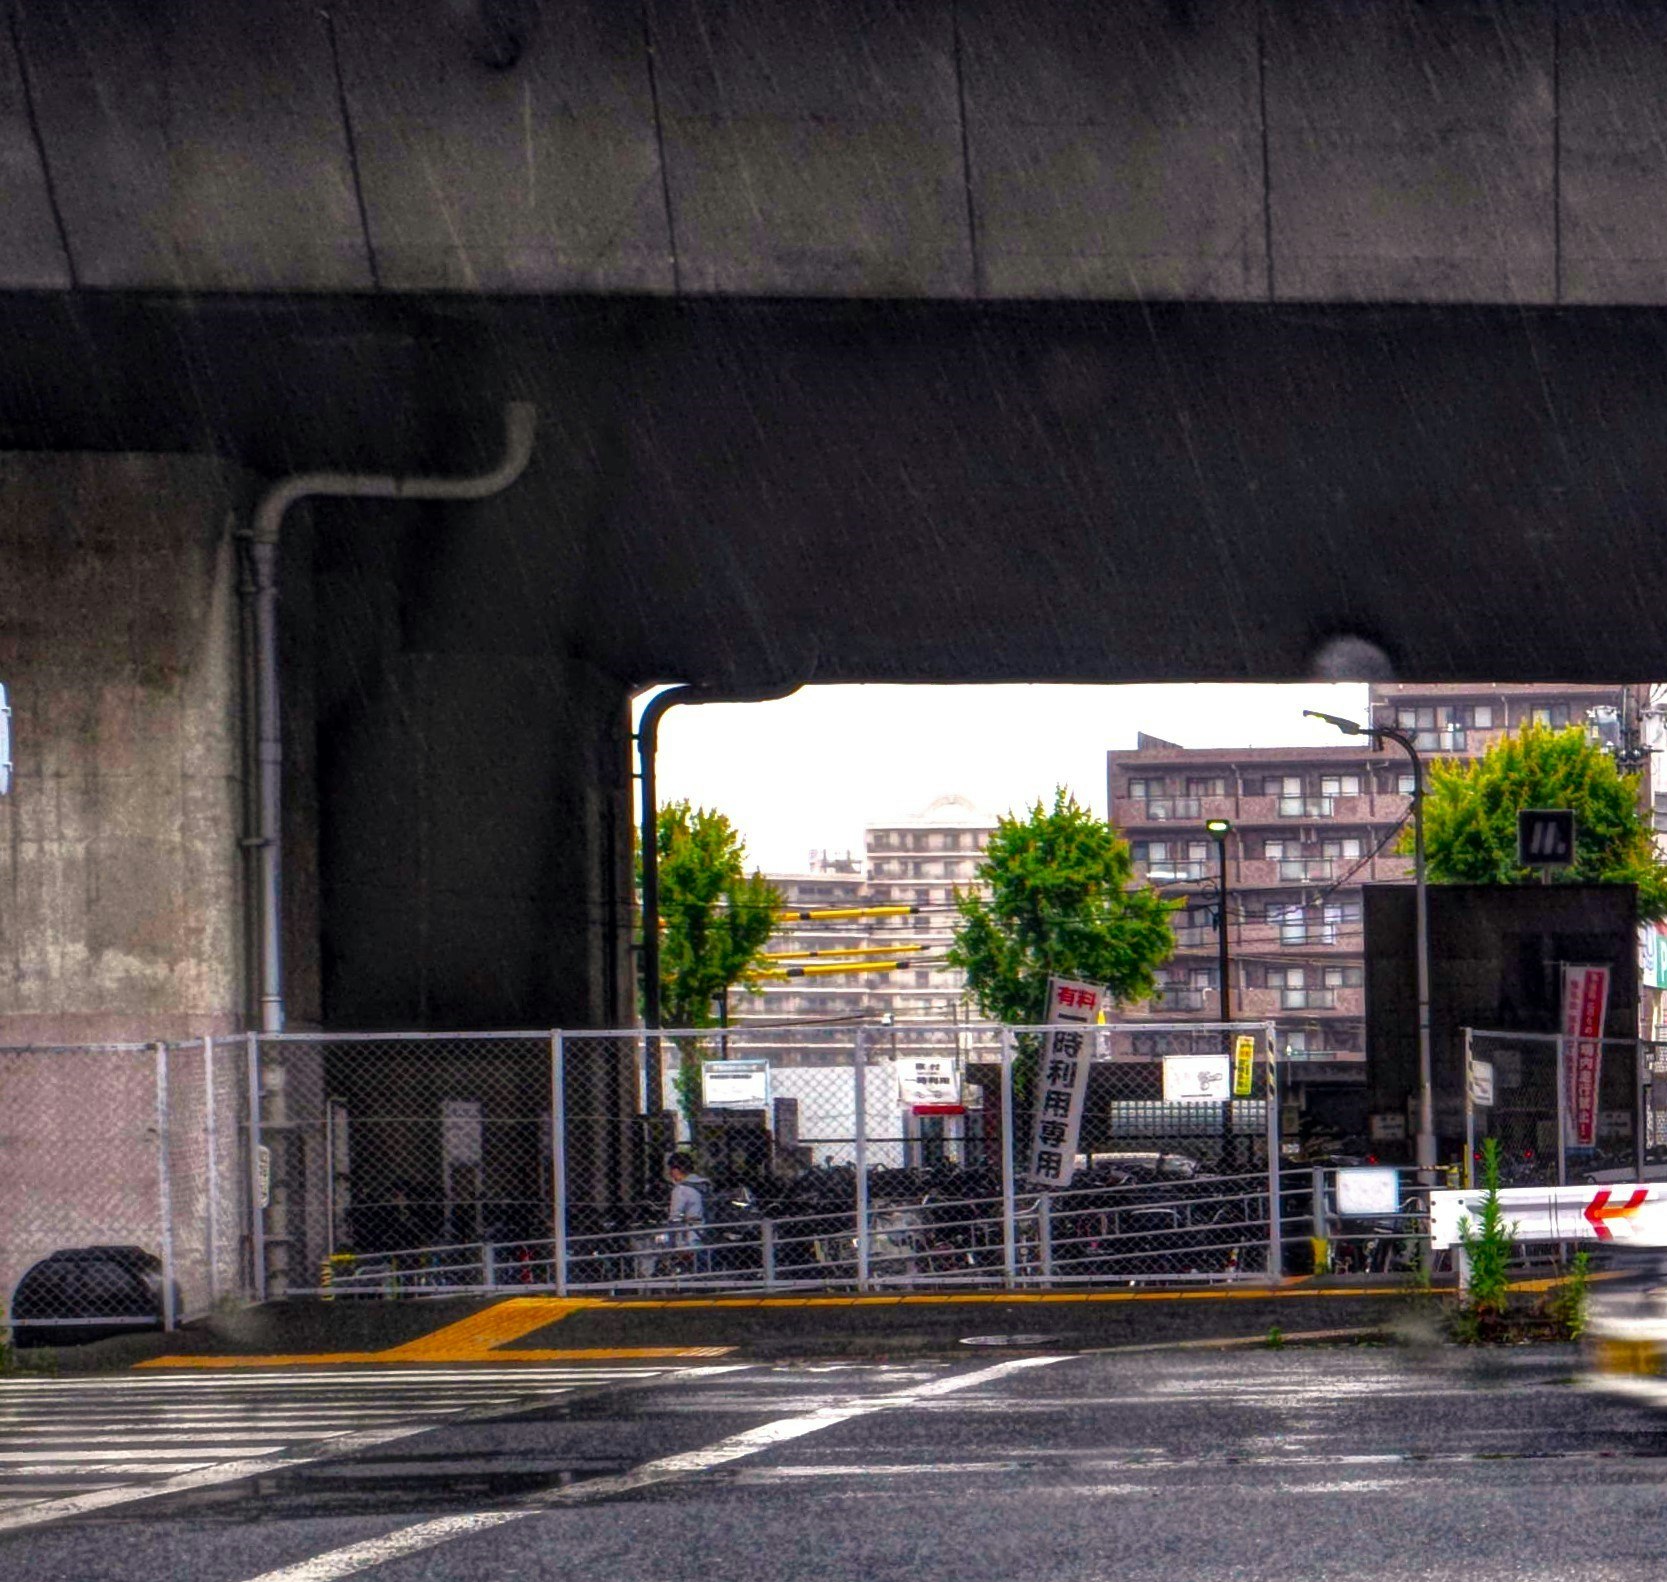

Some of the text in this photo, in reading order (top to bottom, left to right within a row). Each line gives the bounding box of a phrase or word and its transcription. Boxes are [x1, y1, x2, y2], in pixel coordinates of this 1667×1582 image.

[1057, 986, 1097, 1010] 有料
[1037, 1013, 1088, 1179] 一時利用専用
